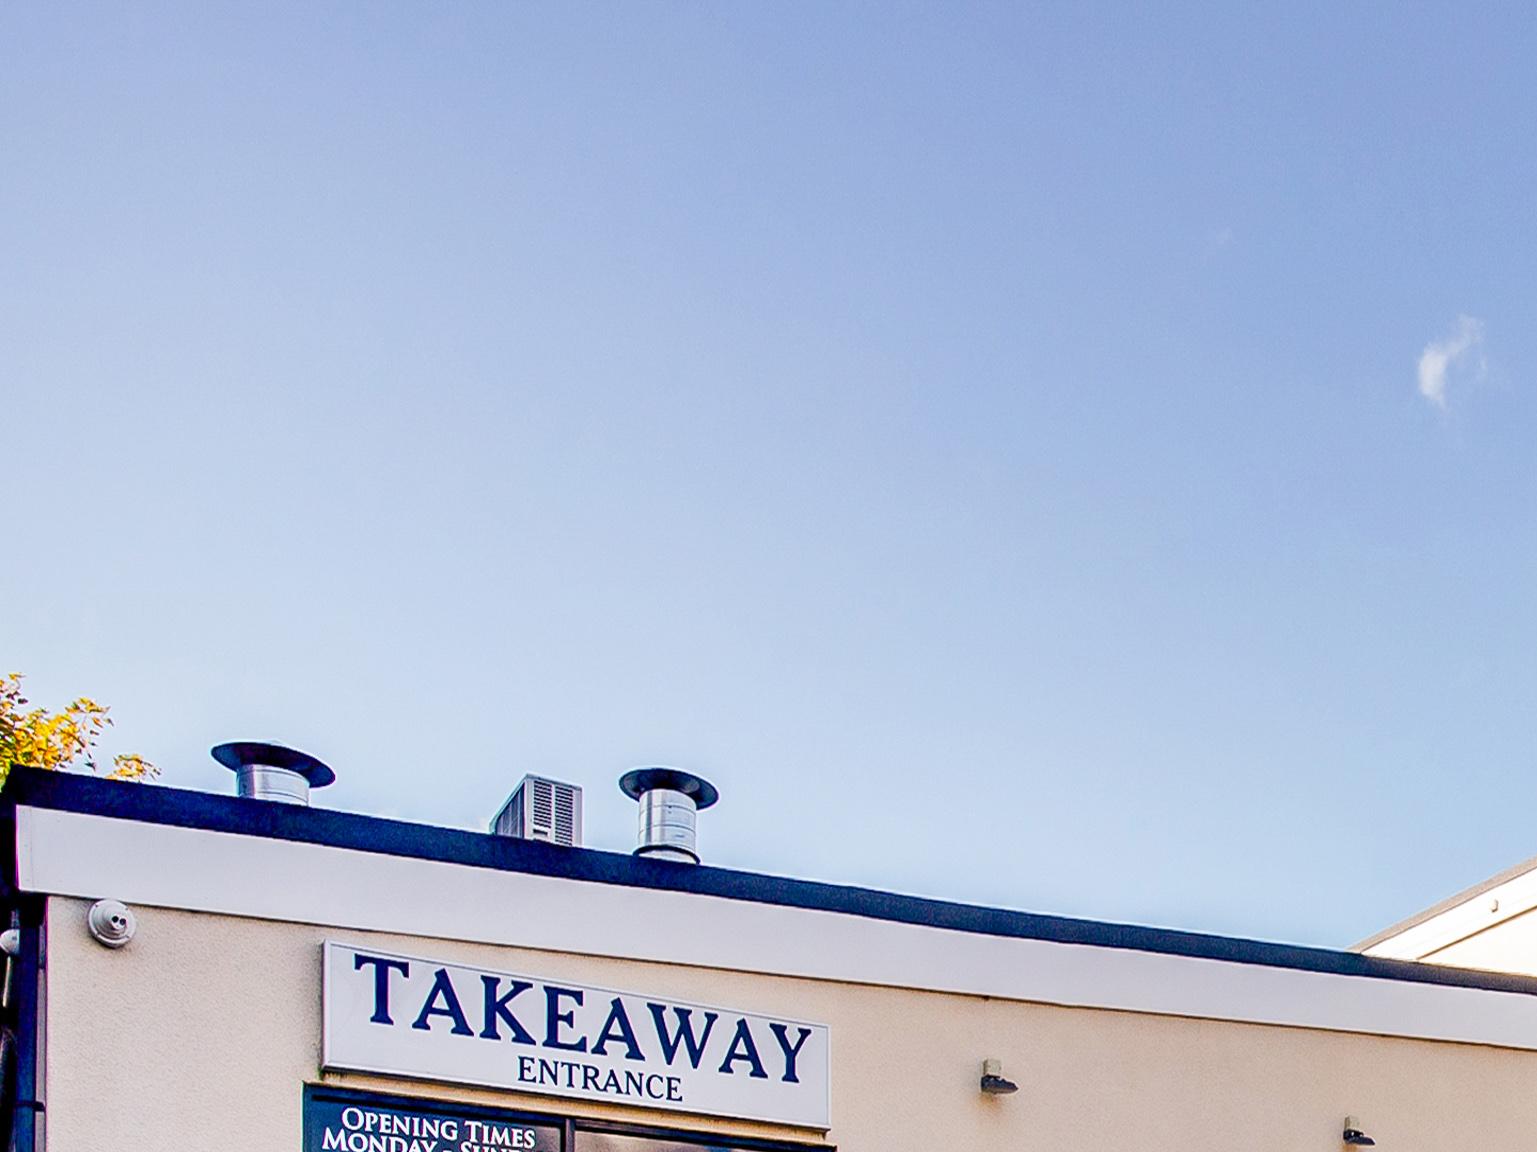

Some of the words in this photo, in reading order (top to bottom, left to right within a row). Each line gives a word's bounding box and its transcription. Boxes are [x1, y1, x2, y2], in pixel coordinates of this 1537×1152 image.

[353, 952, 813, 1084] TAKEAWAY
[517, 1055, 683, 1102] ENTRANCE
[341, 1107, 458, 1141] OPENING
[464, 1120, 536, 1149] TIMES
